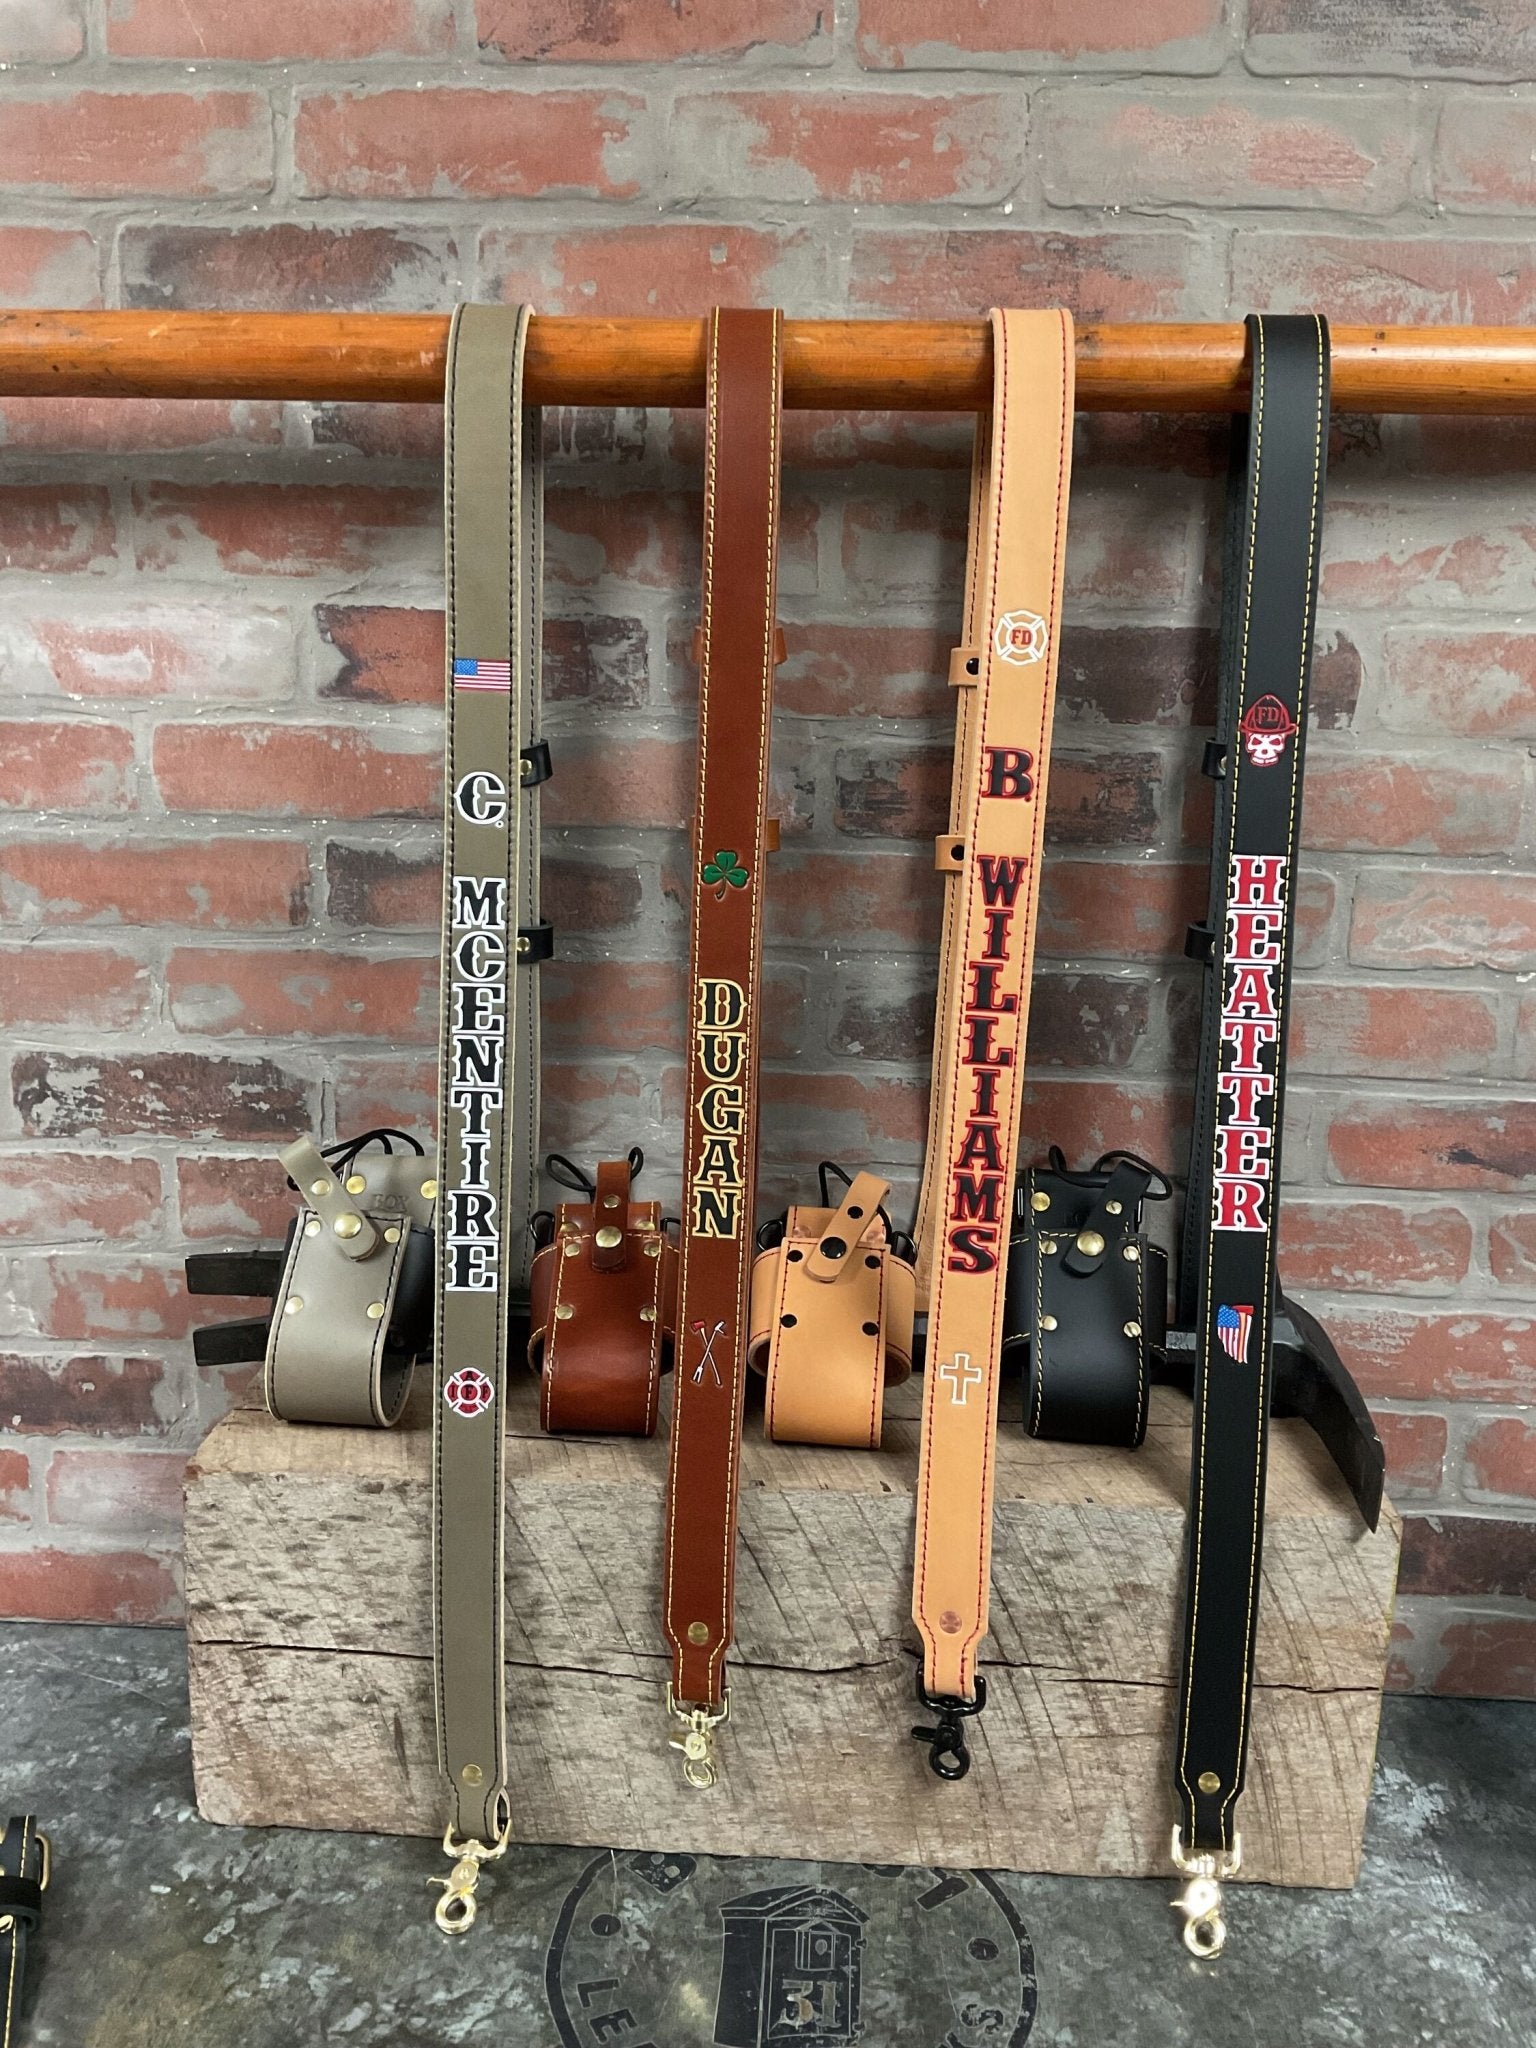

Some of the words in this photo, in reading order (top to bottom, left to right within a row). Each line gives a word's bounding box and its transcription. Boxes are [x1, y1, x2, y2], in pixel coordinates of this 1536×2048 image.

[1011, 629, 1032, 645] FD
[1257, 706, 1280, 724] FD
[445, 876, 506, 1292] MCENTIRE
[692, 978, 748, 1239] DUGAN
[947, 854, 1026, 1273] WILLIAMS
[1210, 854, 1287, 1233] HEATTER
